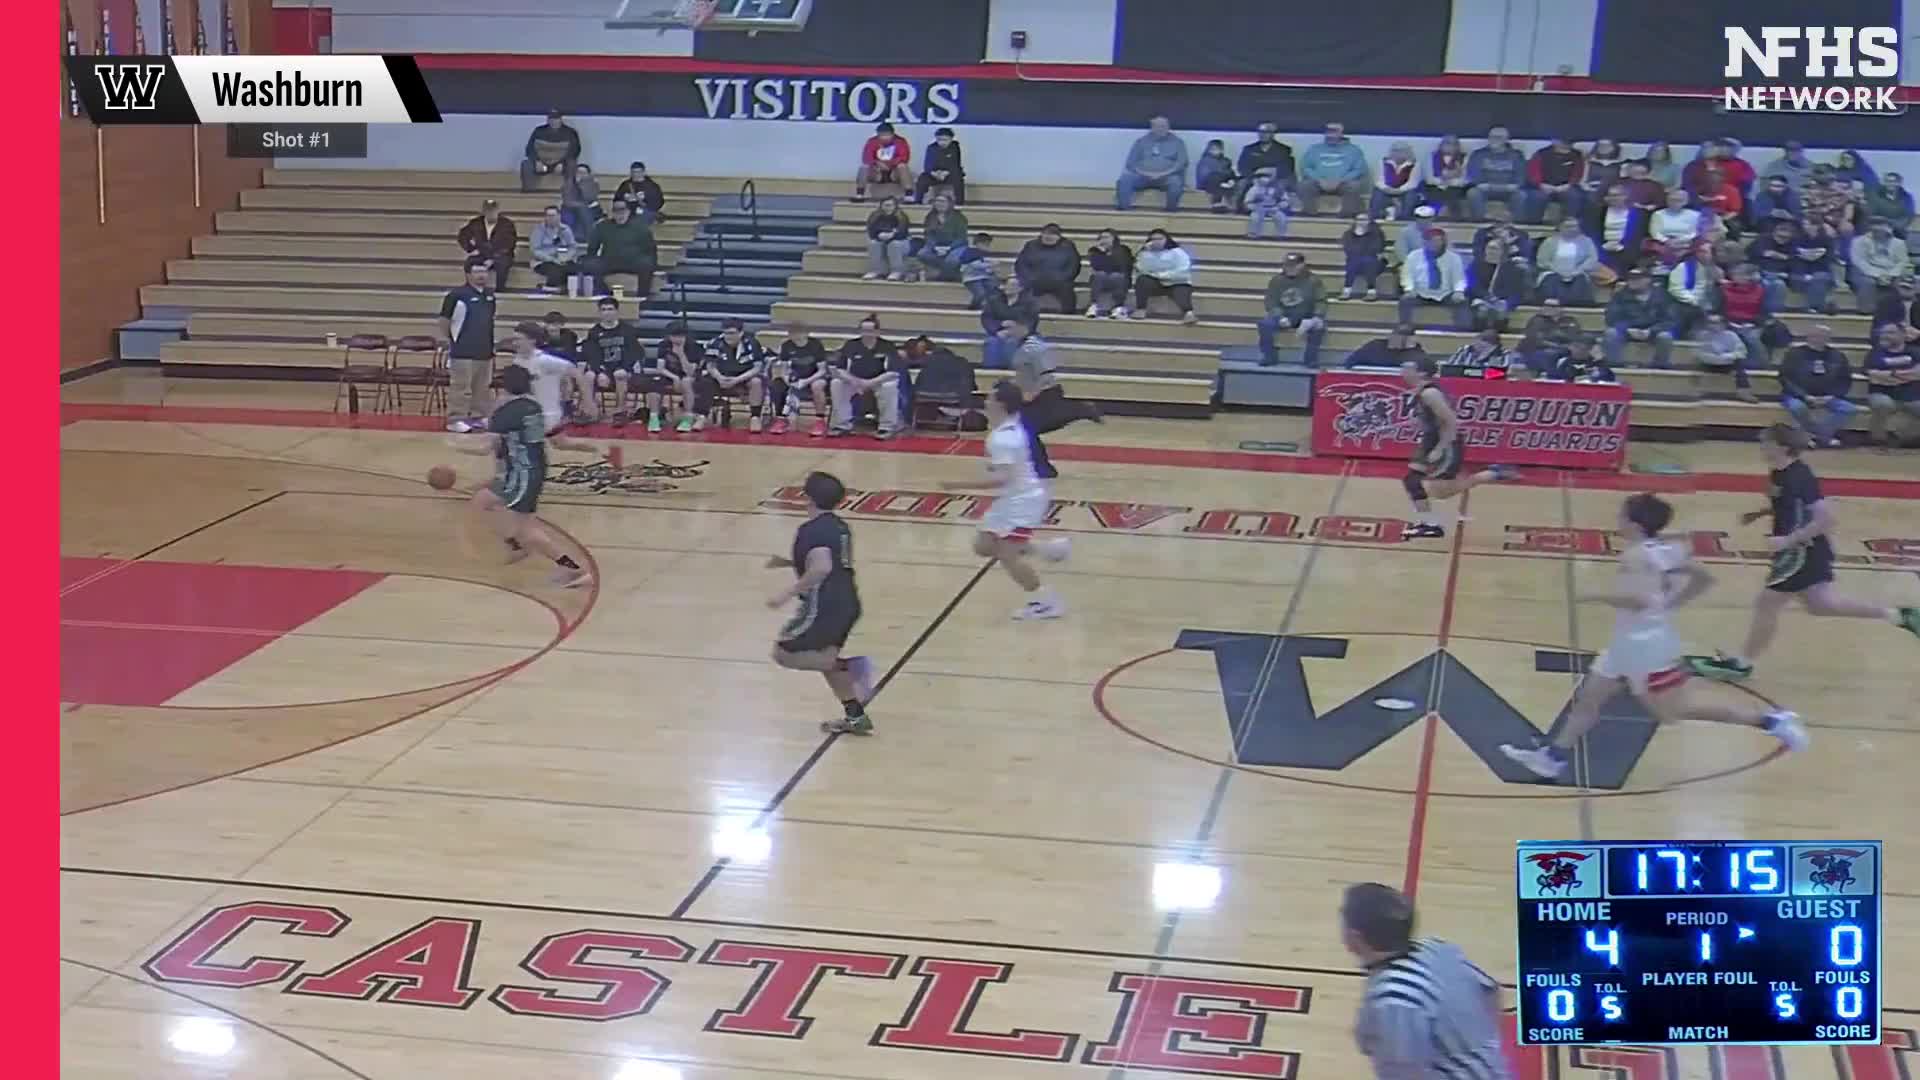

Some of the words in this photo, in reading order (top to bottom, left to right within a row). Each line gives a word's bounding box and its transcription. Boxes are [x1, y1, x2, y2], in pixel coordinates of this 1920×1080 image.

[694, 78, 961, 124] VISITORS
[1399, 389, 1625, 429] WSHBURN
[1511, 430, 1621, 453] GUARDS
[142, 901, 1312, 1080] CASTLE
